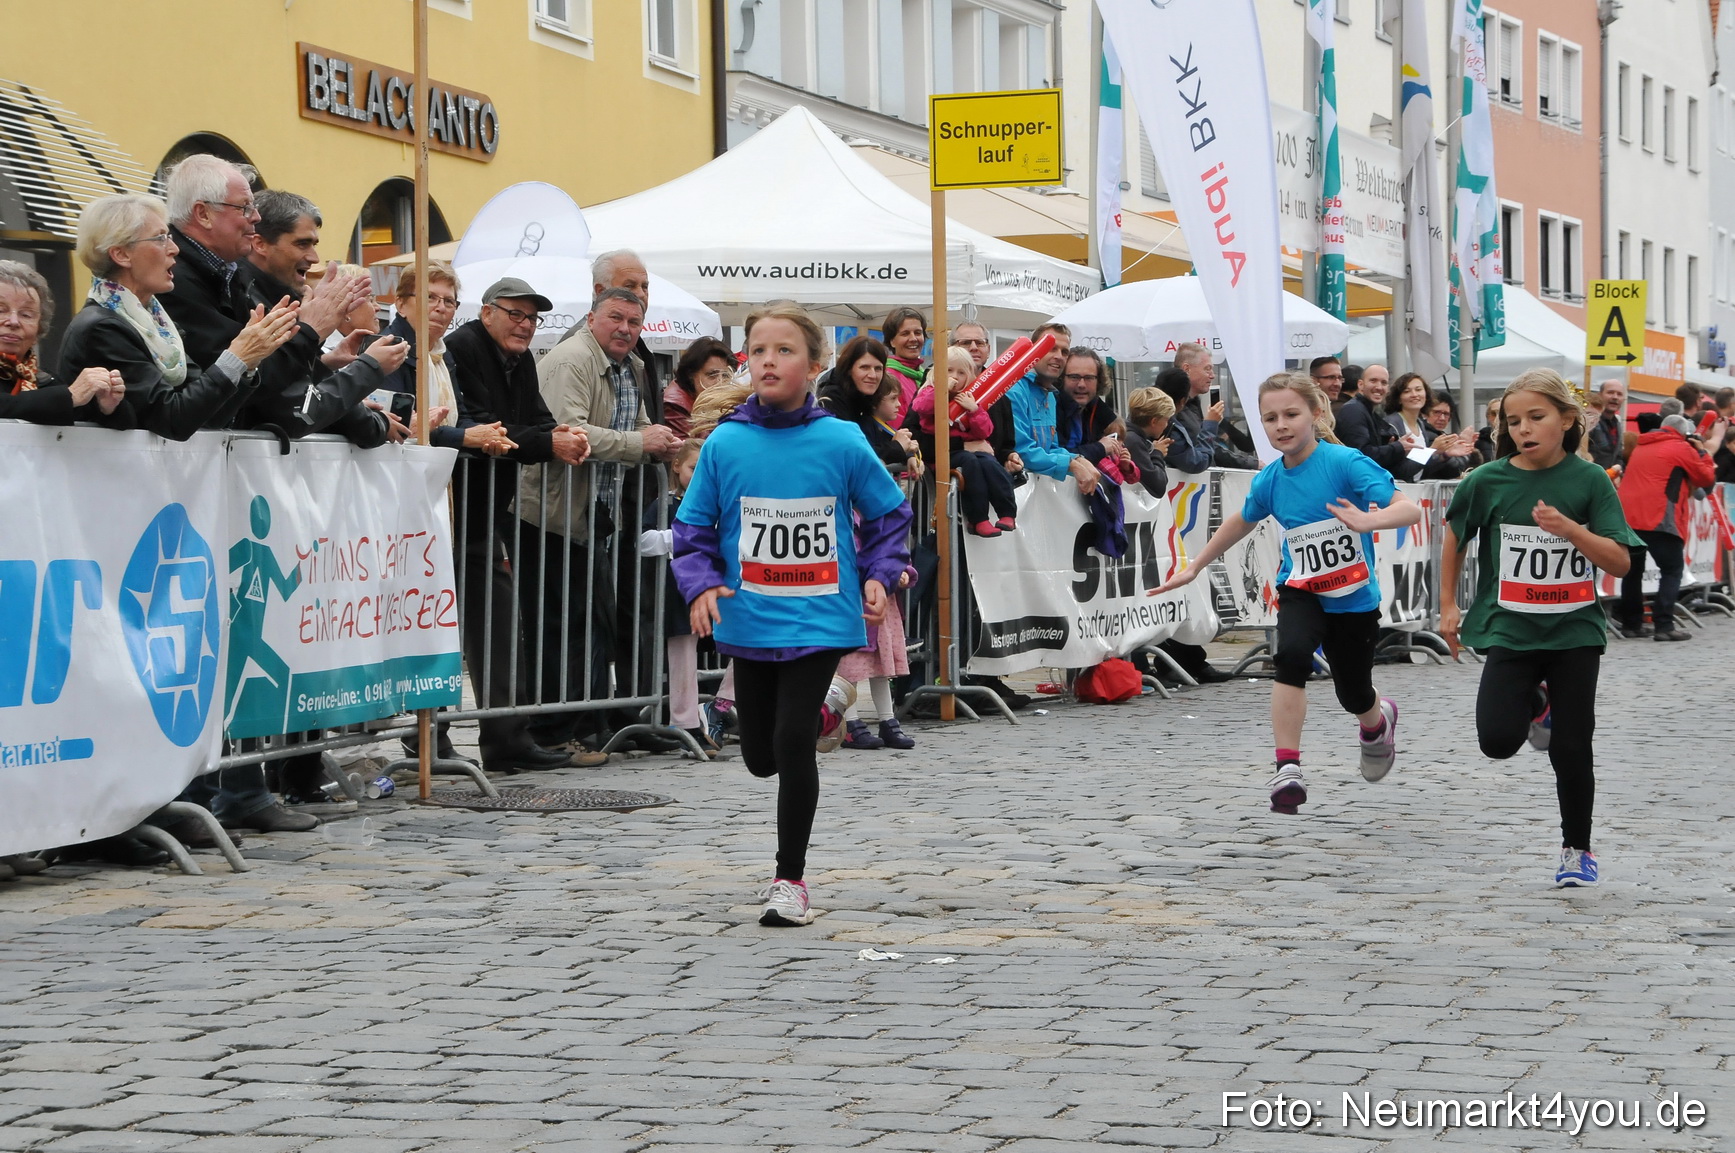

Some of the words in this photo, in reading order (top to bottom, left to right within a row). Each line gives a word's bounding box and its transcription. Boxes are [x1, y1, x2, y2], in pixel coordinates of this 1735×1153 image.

[1169, 41, 1217, 153] BKK
[939, 121, 1052, 141] Schnupper-
[978, 144, 1015, 164] lauf
[1200, 161, 1247, 288] Audi
[697, 262, 908, 280] www.audibkk.de
[985, 263, 1002, 285] Von
[1037, 277, 1055, 297] uns:
[1056, 278, 1074, 301] Audi
[1074, 281, 1091, 302] BKK
[1594, 283, 1640, 299] Block
[673, 320, 702, 335] BKK
[1597, 306, 1631, 347] A
[1164, 338, 1207, 353] Adi
[979, 367, 996, 383] BKK
[743, 506, 773, 519] PARTL
[775, 508, 821, 519] Neumarkt
[751, 522, 830, 560] 7065
[1304, 525, 1345, 542] Neumarkt
[1502, 532, 1534, 544] PARTL
[1536, 535, 1570, 544] Neuma
[1294, 534, 1357, 576] 7063
[1509, 546, 1587, 580] 7076
[763, 568, 815, 583] Samina
[1305, 574, 1348, 593] Tamina
[1525, 587, 1570, 604] Svenja
